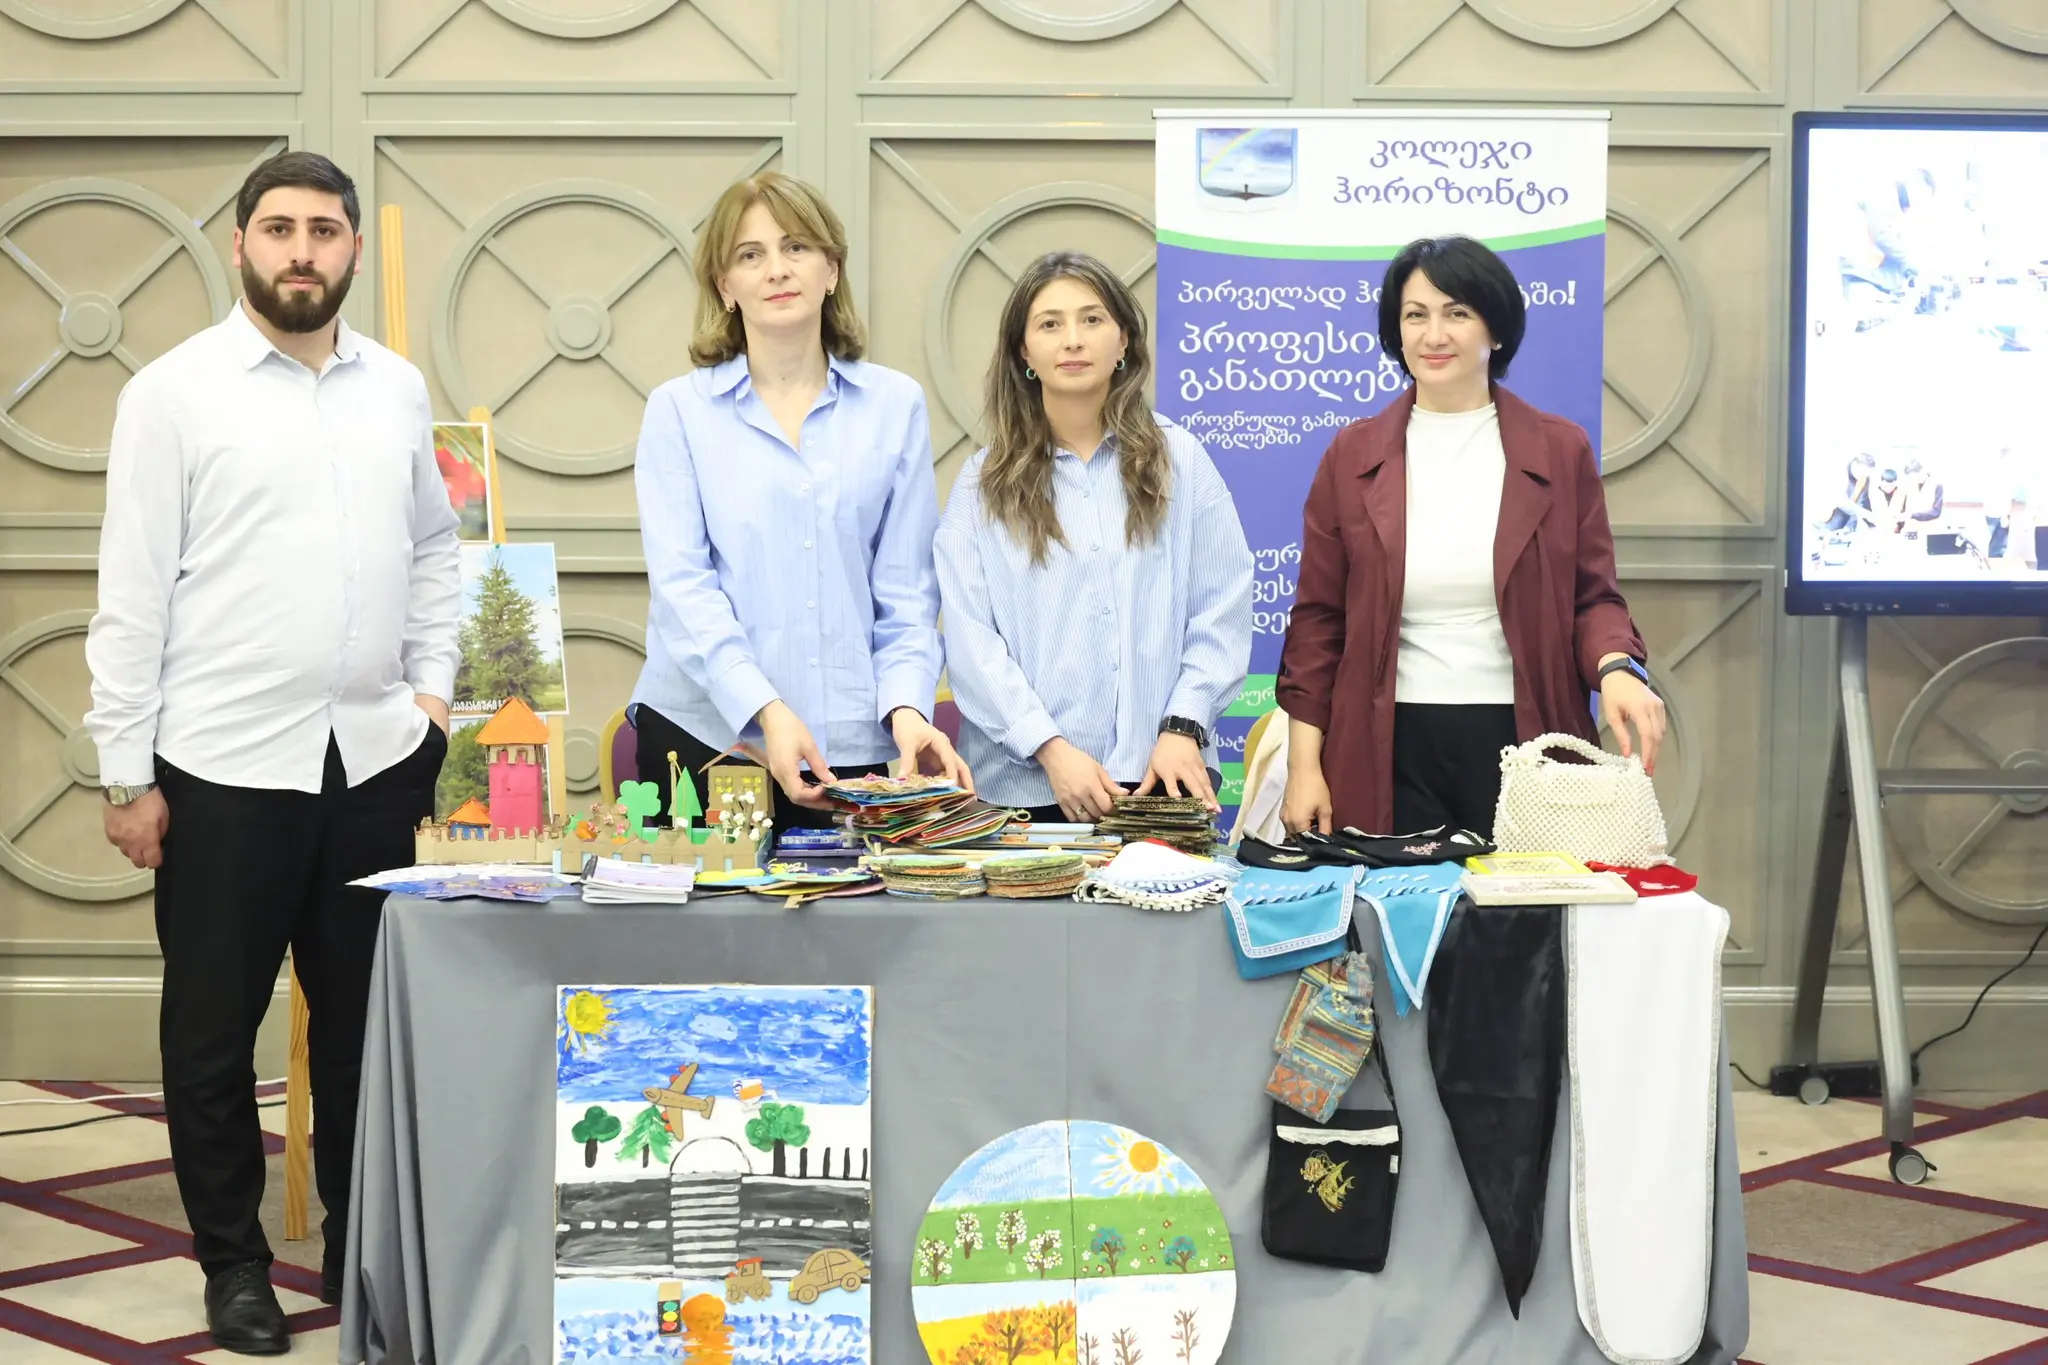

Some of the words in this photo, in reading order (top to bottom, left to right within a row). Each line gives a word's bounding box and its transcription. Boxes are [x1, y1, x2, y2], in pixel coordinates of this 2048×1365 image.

[1369, 140, 1533, 169] კოლეჯი
[1333, 176, 1569, 215] ჰორიზონტი
[1177, 279, 1347, 311] პირველად
[1178, 321, 1386, 365] პროფესი
[1179, 358, 1409, 403] განათლებ
[1180, 411, 1297, 433] ეროვნული
[1301, 411, 1362, 432] გამო
[1194, 428, 1301, 450] არგლებში
